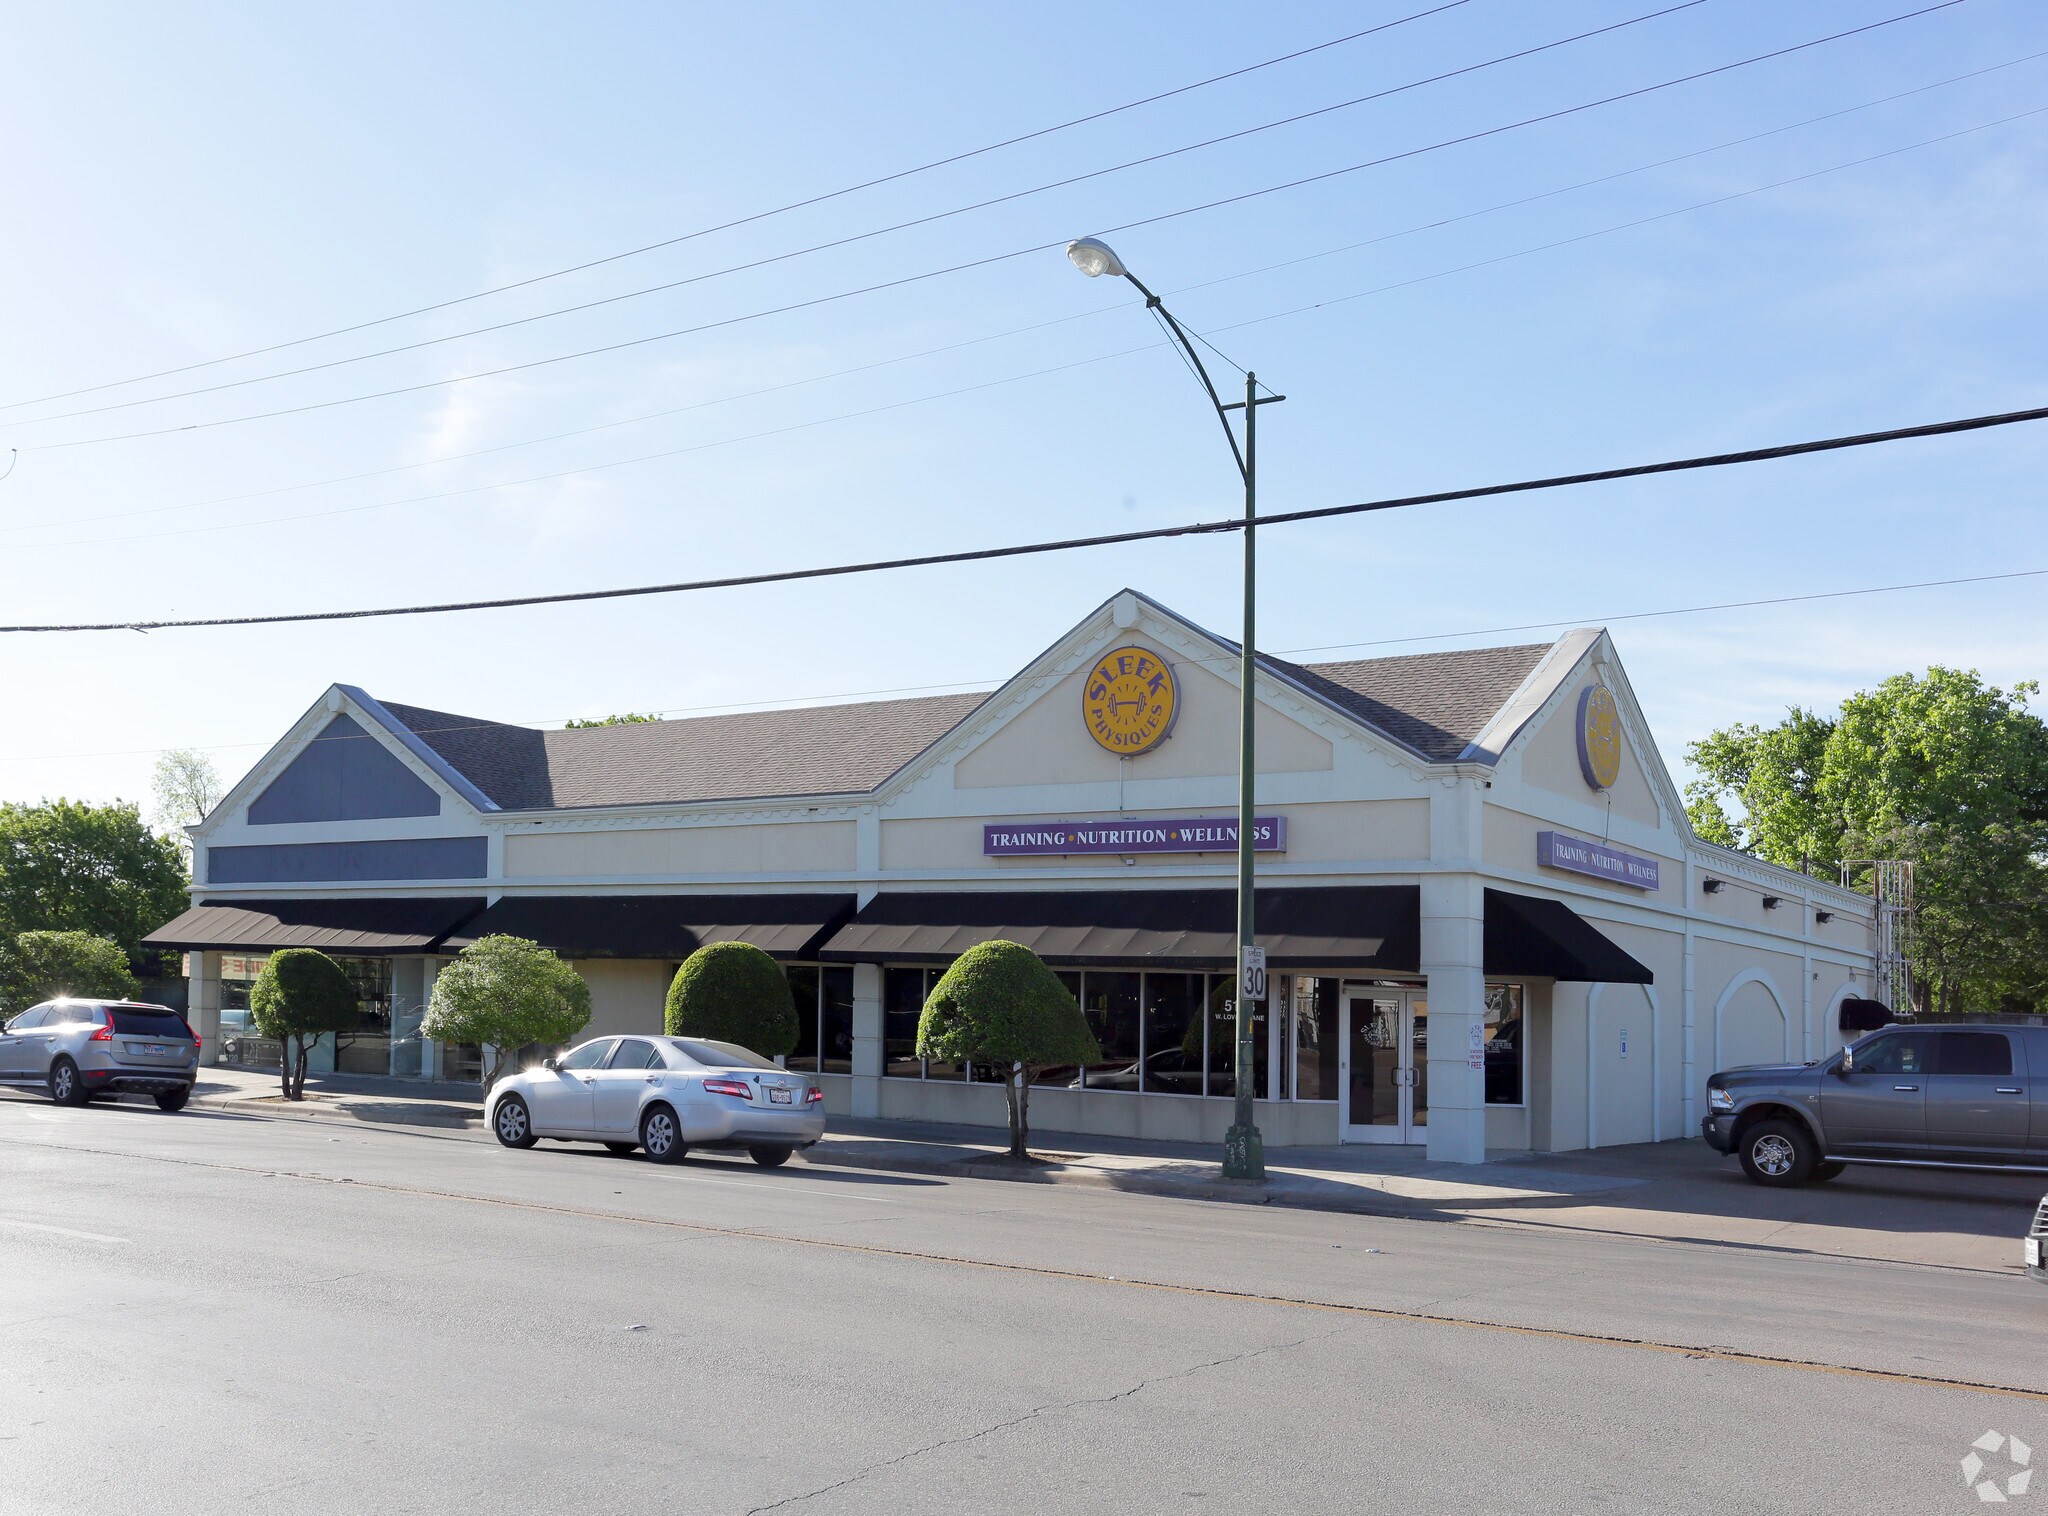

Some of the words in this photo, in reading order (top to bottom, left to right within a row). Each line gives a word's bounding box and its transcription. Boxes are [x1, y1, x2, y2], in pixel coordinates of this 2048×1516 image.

[1089, 655, 1168, 701] SLEEK
[1092, 704, 1163, 746] PHYSIQUES
[990, 832, 1066, 847] TRAINING
[1077, 829, 1167, 845] NUTRITION
[1180, 826, 1271, 842] WELLNSS
[1555, 843, 1587, 864] TRAINING
[1591, 853, 1624, 873] NUTRITION
[1627, 862, 1657, 881] WELLNESS
[1244, 966, 1264, 996] 30
